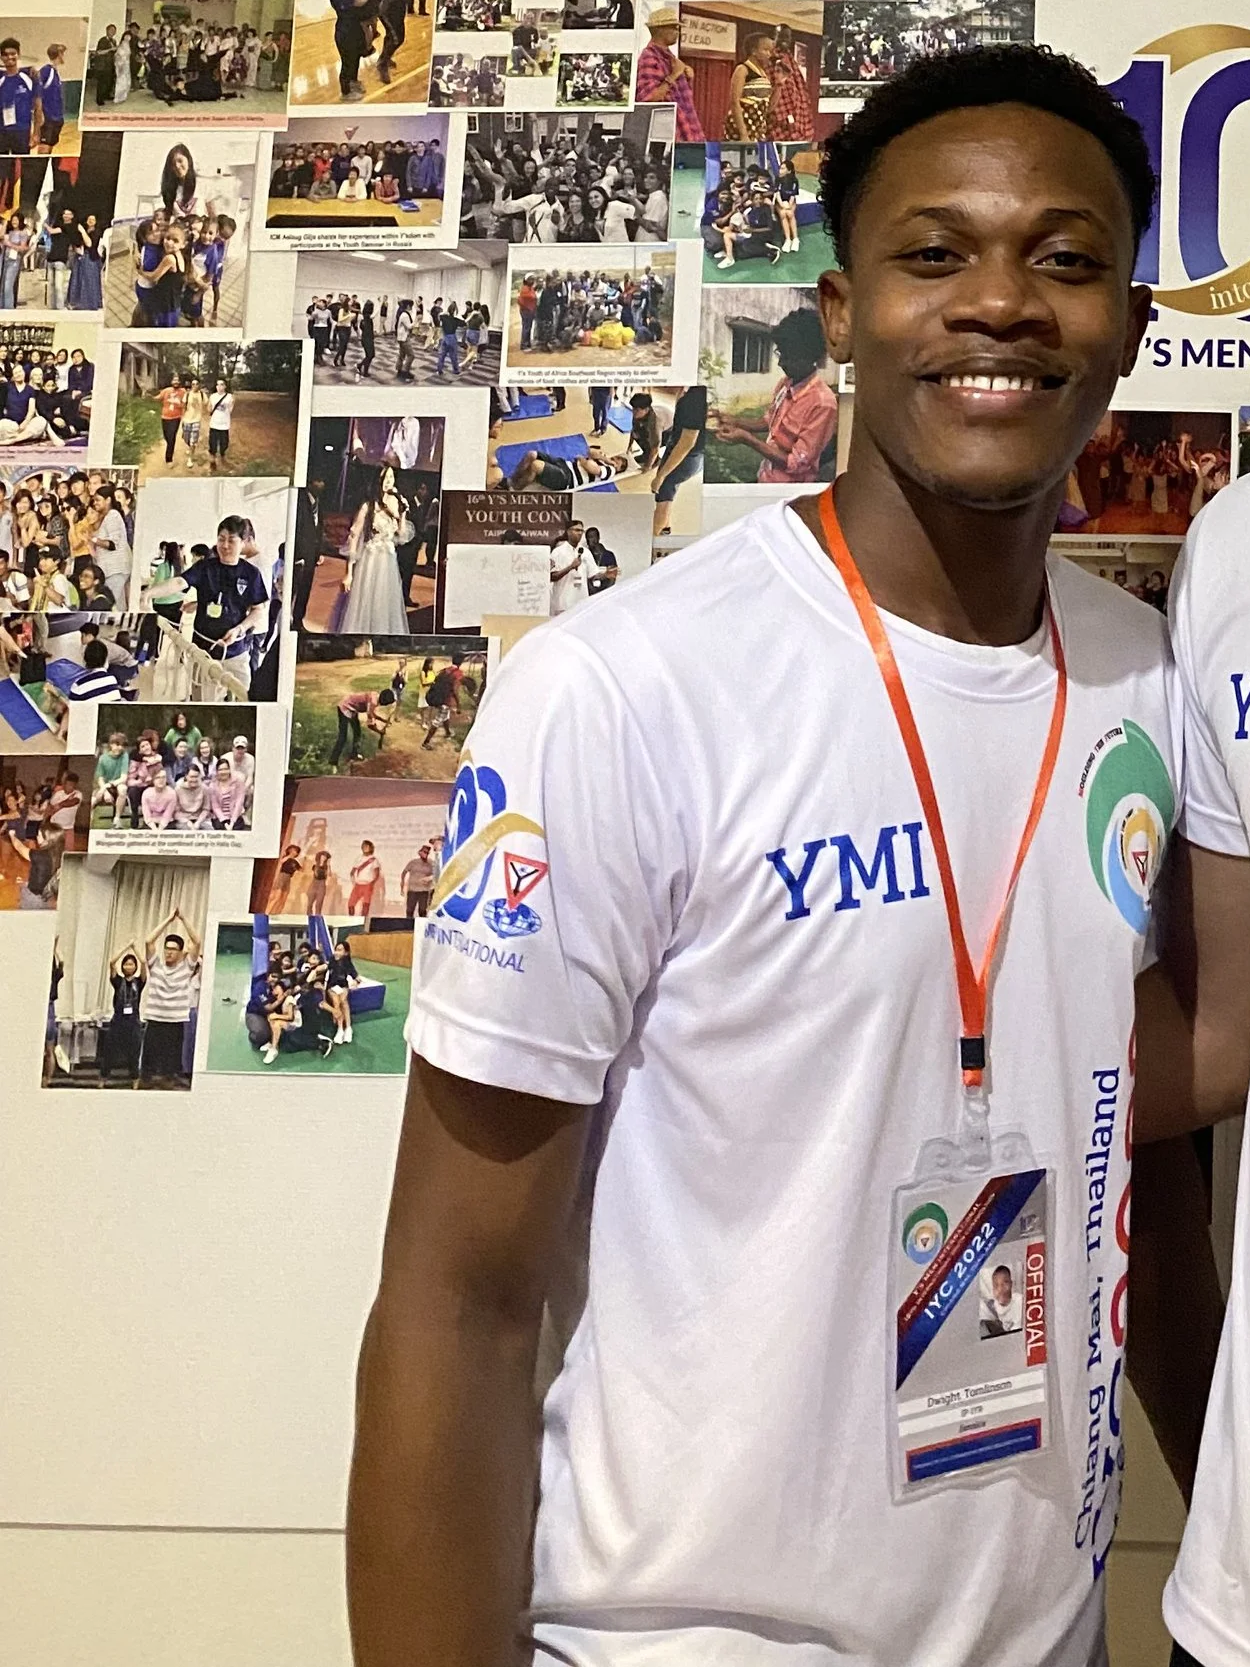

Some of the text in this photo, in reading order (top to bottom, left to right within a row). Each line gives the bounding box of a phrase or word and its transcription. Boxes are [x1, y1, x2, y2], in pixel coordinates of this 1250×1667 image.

[689, 34, 711, 45] LEAD
[488, 494, 507, 504] Y'S
[511, 494, 538, 504] MEN
[466, 510, 522, 523] YOUTH
[766, 822, 930, 921] YMI
[922, 1279, 955, 1319] IYC
[950, 1220, 996, 1278] 2022
[1026, 1253, 1045, 1357] OFFICIAL
[927, 1381, 1012, 1408] Dwight Tomlinson
